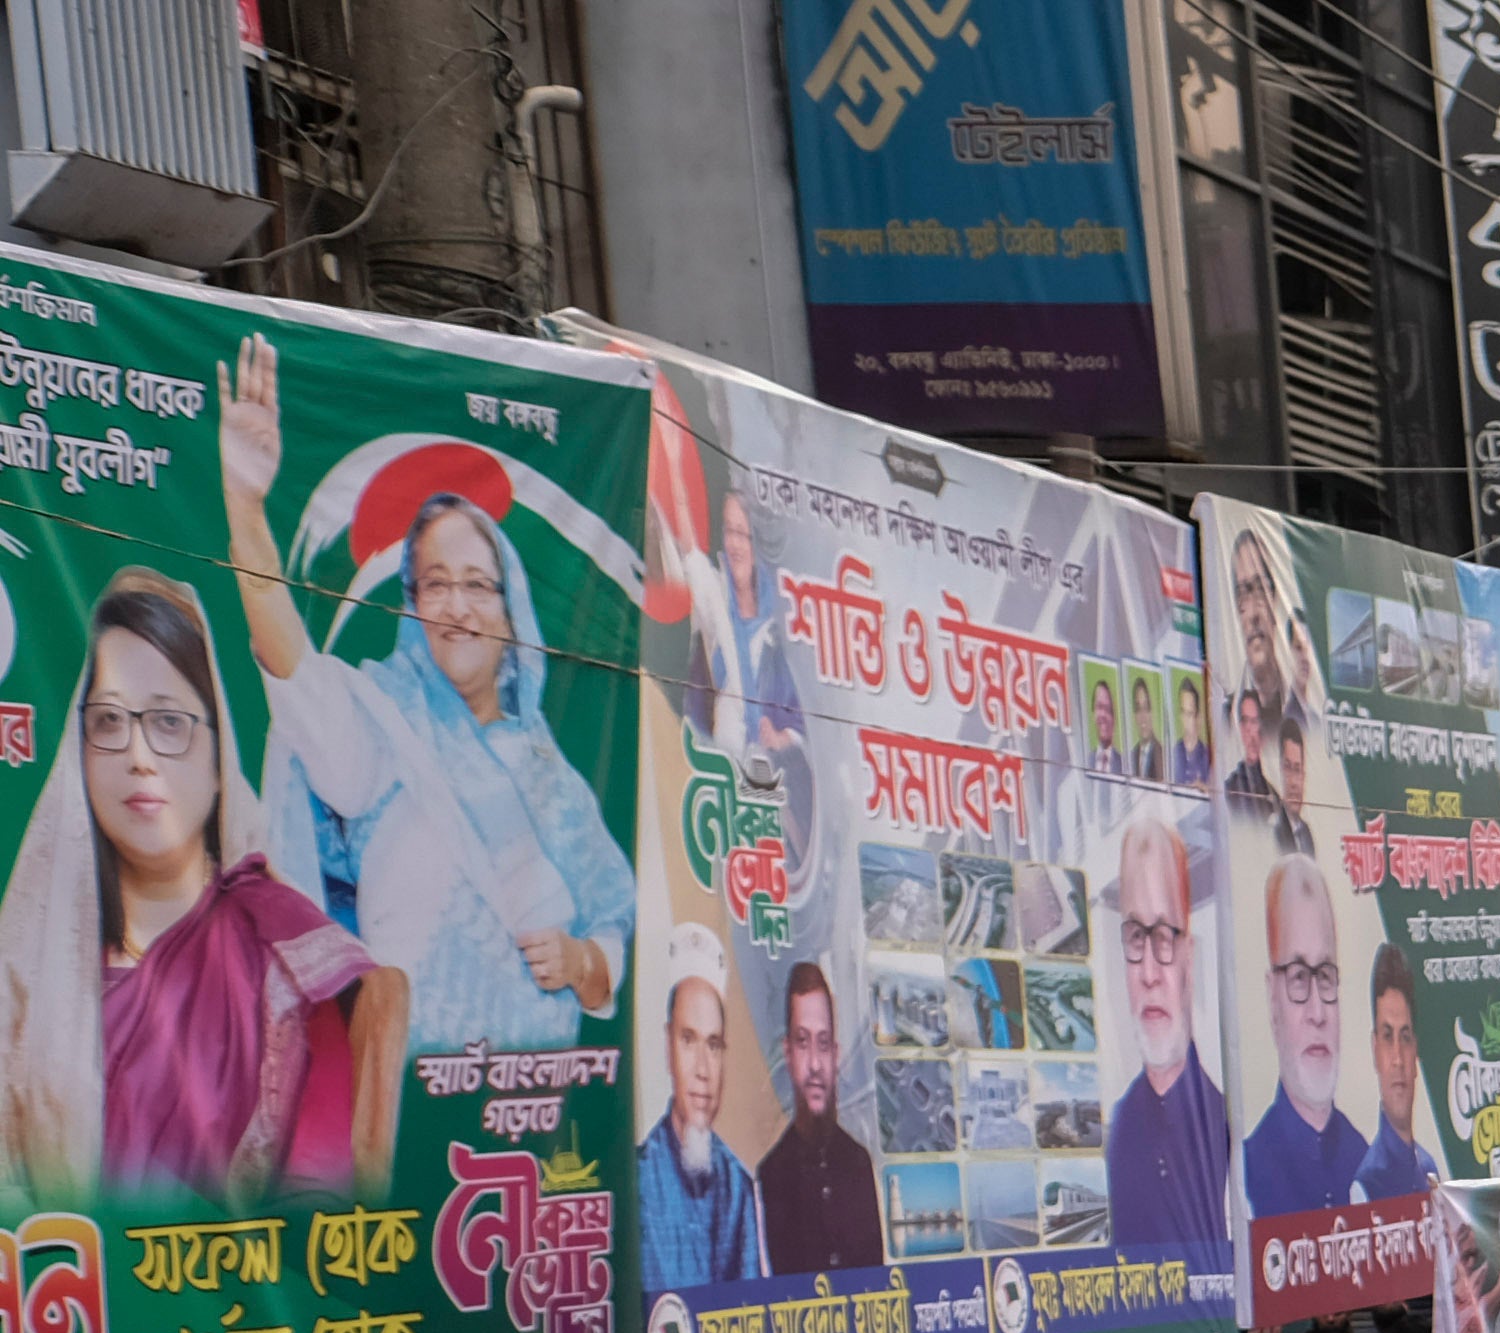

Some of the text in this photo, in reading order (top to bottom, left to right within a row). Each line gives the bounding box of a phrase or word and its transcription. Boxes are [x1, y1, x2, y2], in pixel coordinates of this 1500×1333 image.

[947, 103, 1117, 167] টেইলার্স
[124, 366, 206, 420] ধারক
[465, 391, 560, 447] জয় বঙ্গবন্ধু
[753, 465, 1084, 602] ঢাকা মহানগর দক্ষিণ আওয়ামী লীগ এর
[779, 553, 886, 692] শান্তি
[898, 608, 931, 704] ও
[936, 589, 1072, 734] উন্নয়ন
[857, 726, 1027, 846] সমাবেশ
[1340, 813, 1470, 901] স্মার্ট বাংলাদেশ
[416, 1038, 620, 1094] স্মার্ট বাংলাদেশ
[482, 1095, 563, 1143] গড়তে
[126, 1205, 423, 1297] সফল হোক
[1116, 1248, 1156, 1310] ইসলাম
[1286, 1232, 1319, 1287] মোঃ
